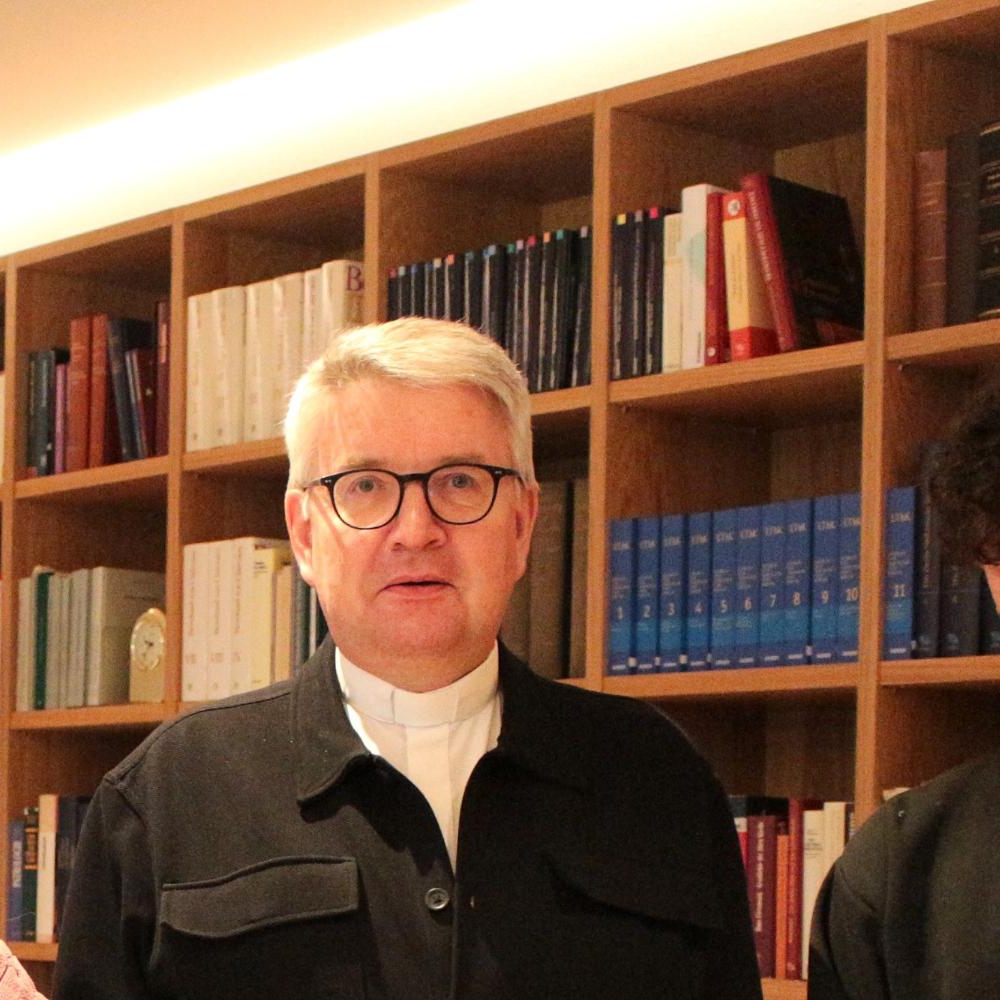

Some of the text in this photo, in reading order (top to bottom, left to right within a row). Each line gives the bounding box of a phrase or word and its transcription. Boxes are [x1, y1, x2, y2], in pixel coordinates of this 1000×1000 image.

[821, 590, 830, 605] 9
[845, 586, 859, 602] 10
[892, 583, 906, 598] 11
[744, 596, 753, 612] 6
[768, 593, 777, 608] 7
[792, 591, 802, 606] 8
[642, 604, 651, 618] 2
[666, 602, 676, 616] 3
[694, 601, 704, 615] 4
[720, 599, 729, 614] 5
